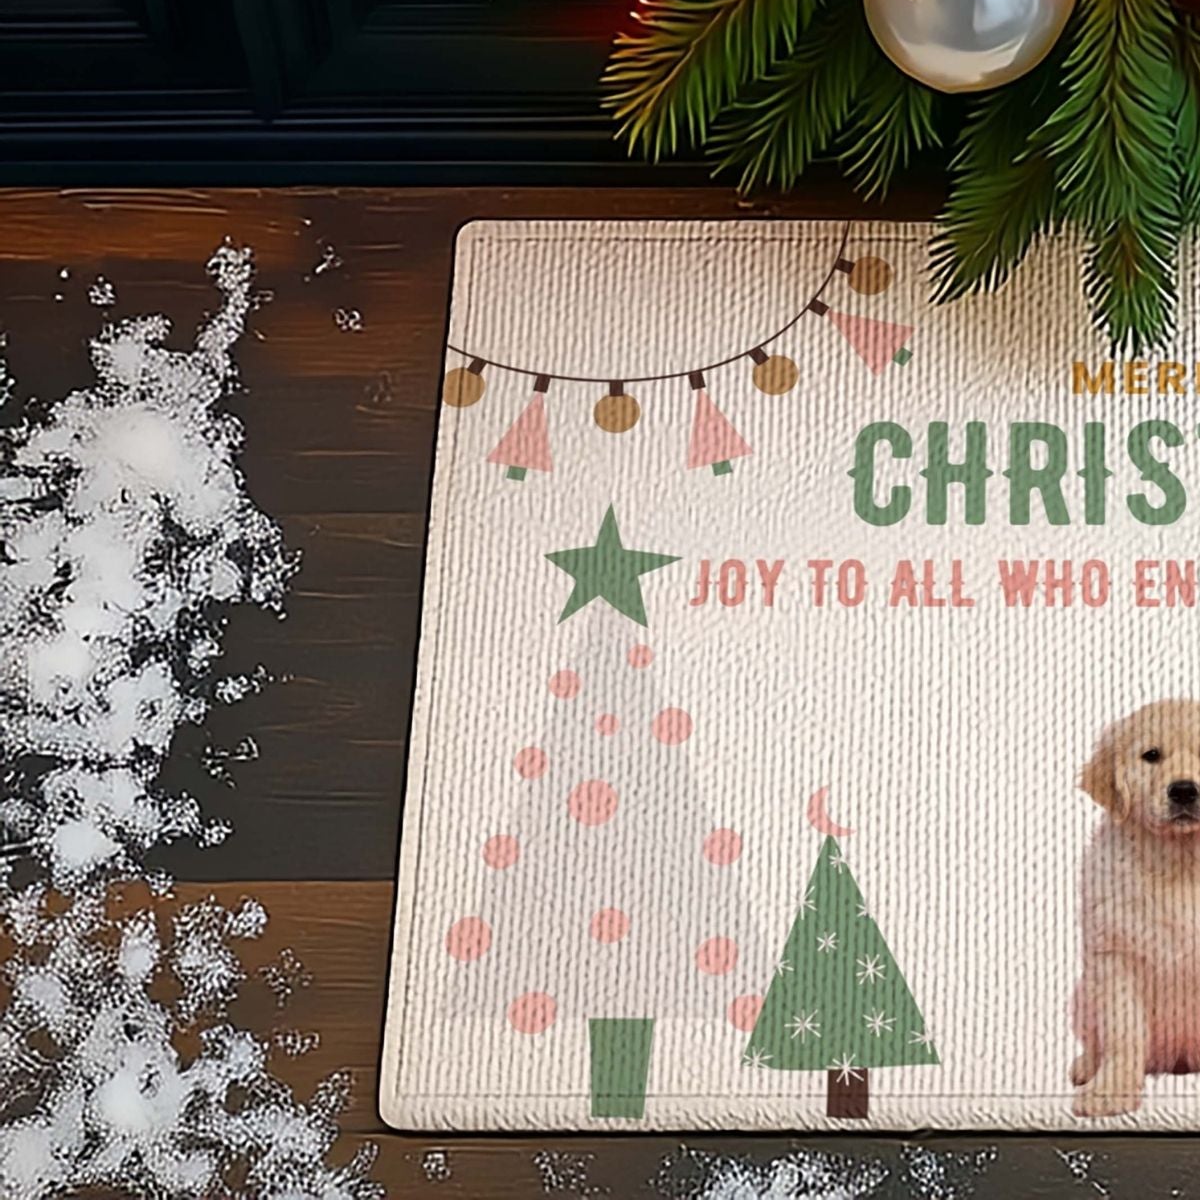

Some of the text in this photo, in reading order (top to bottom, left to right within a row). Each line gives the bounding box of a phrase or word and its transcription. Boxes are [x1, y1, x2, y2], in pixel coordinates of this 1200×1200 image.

[689, 558, 786, 608] JOY
[807, 558, 868, 608] TO
[889, 558, 976, 608] ALL
[998, 558, 1112, 608] WHO
